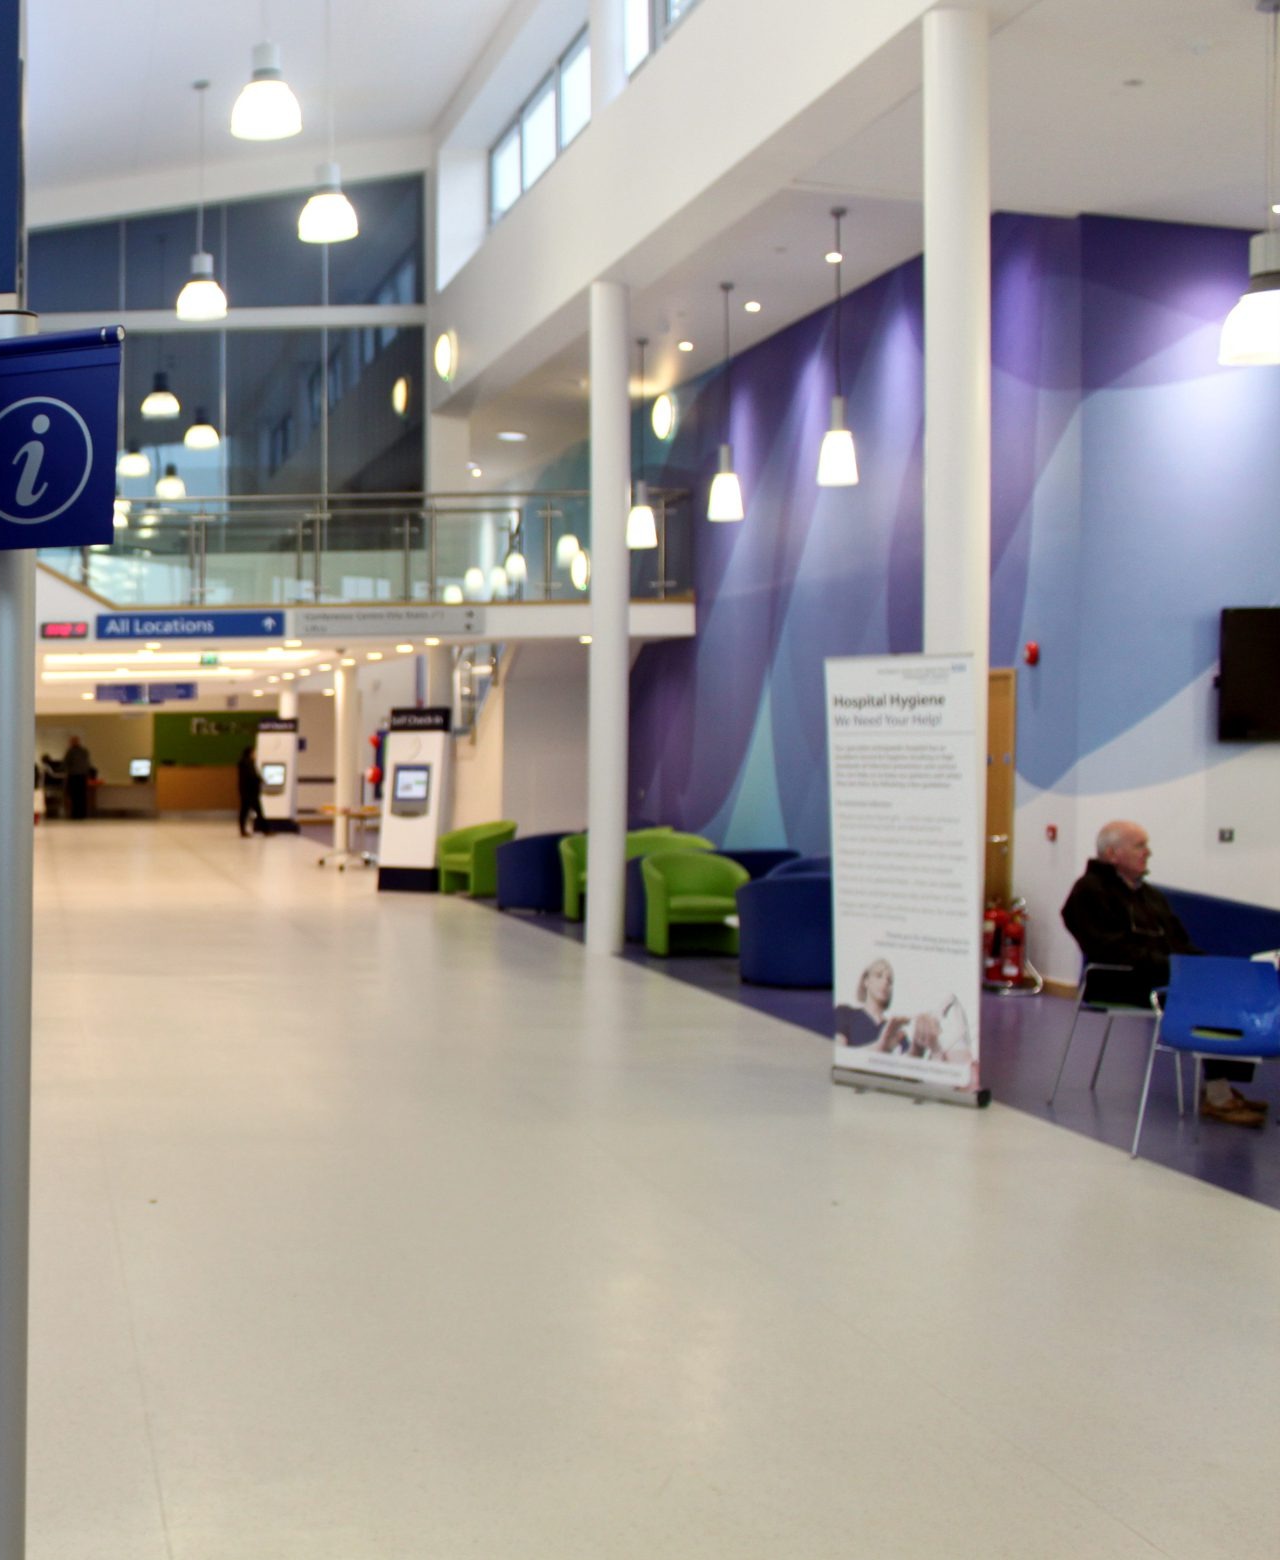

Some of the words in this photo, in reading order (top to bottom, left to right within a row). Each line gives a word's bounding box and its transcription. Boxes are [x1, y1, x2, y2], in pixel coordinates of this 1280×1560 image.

[106, 619, 129, 633] All
[134, 619, 214, 634] Locations
[833, 694, 887, 710] Hospital
[890, 694, 946, 710] Hygiene
[854, 715, 882, 726] Need
[885, 715, 909, 726] Your
